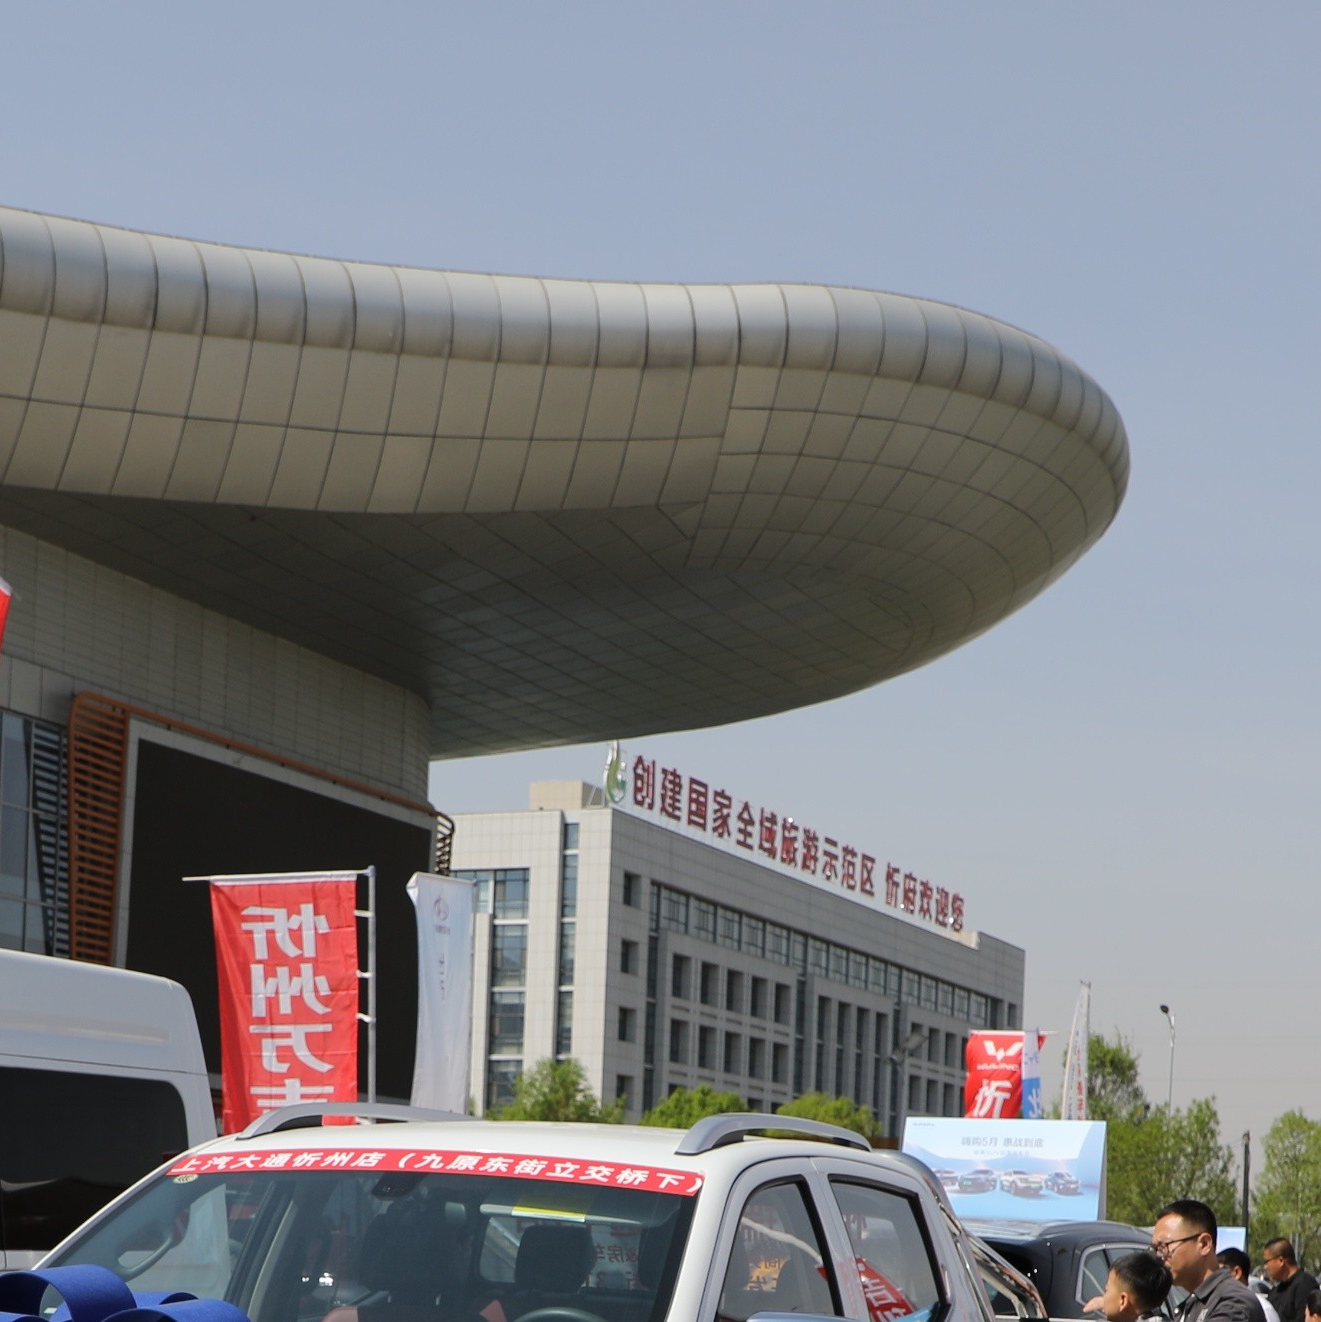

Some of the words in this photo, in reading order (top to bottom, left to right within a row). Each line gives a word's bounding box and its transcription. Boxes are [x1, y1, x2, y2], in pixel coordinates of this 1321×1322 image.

[632, 754, 876, 898] 创建国家全域旅游示范区
[885, 861, 966, 932] 忻府欢迎您
